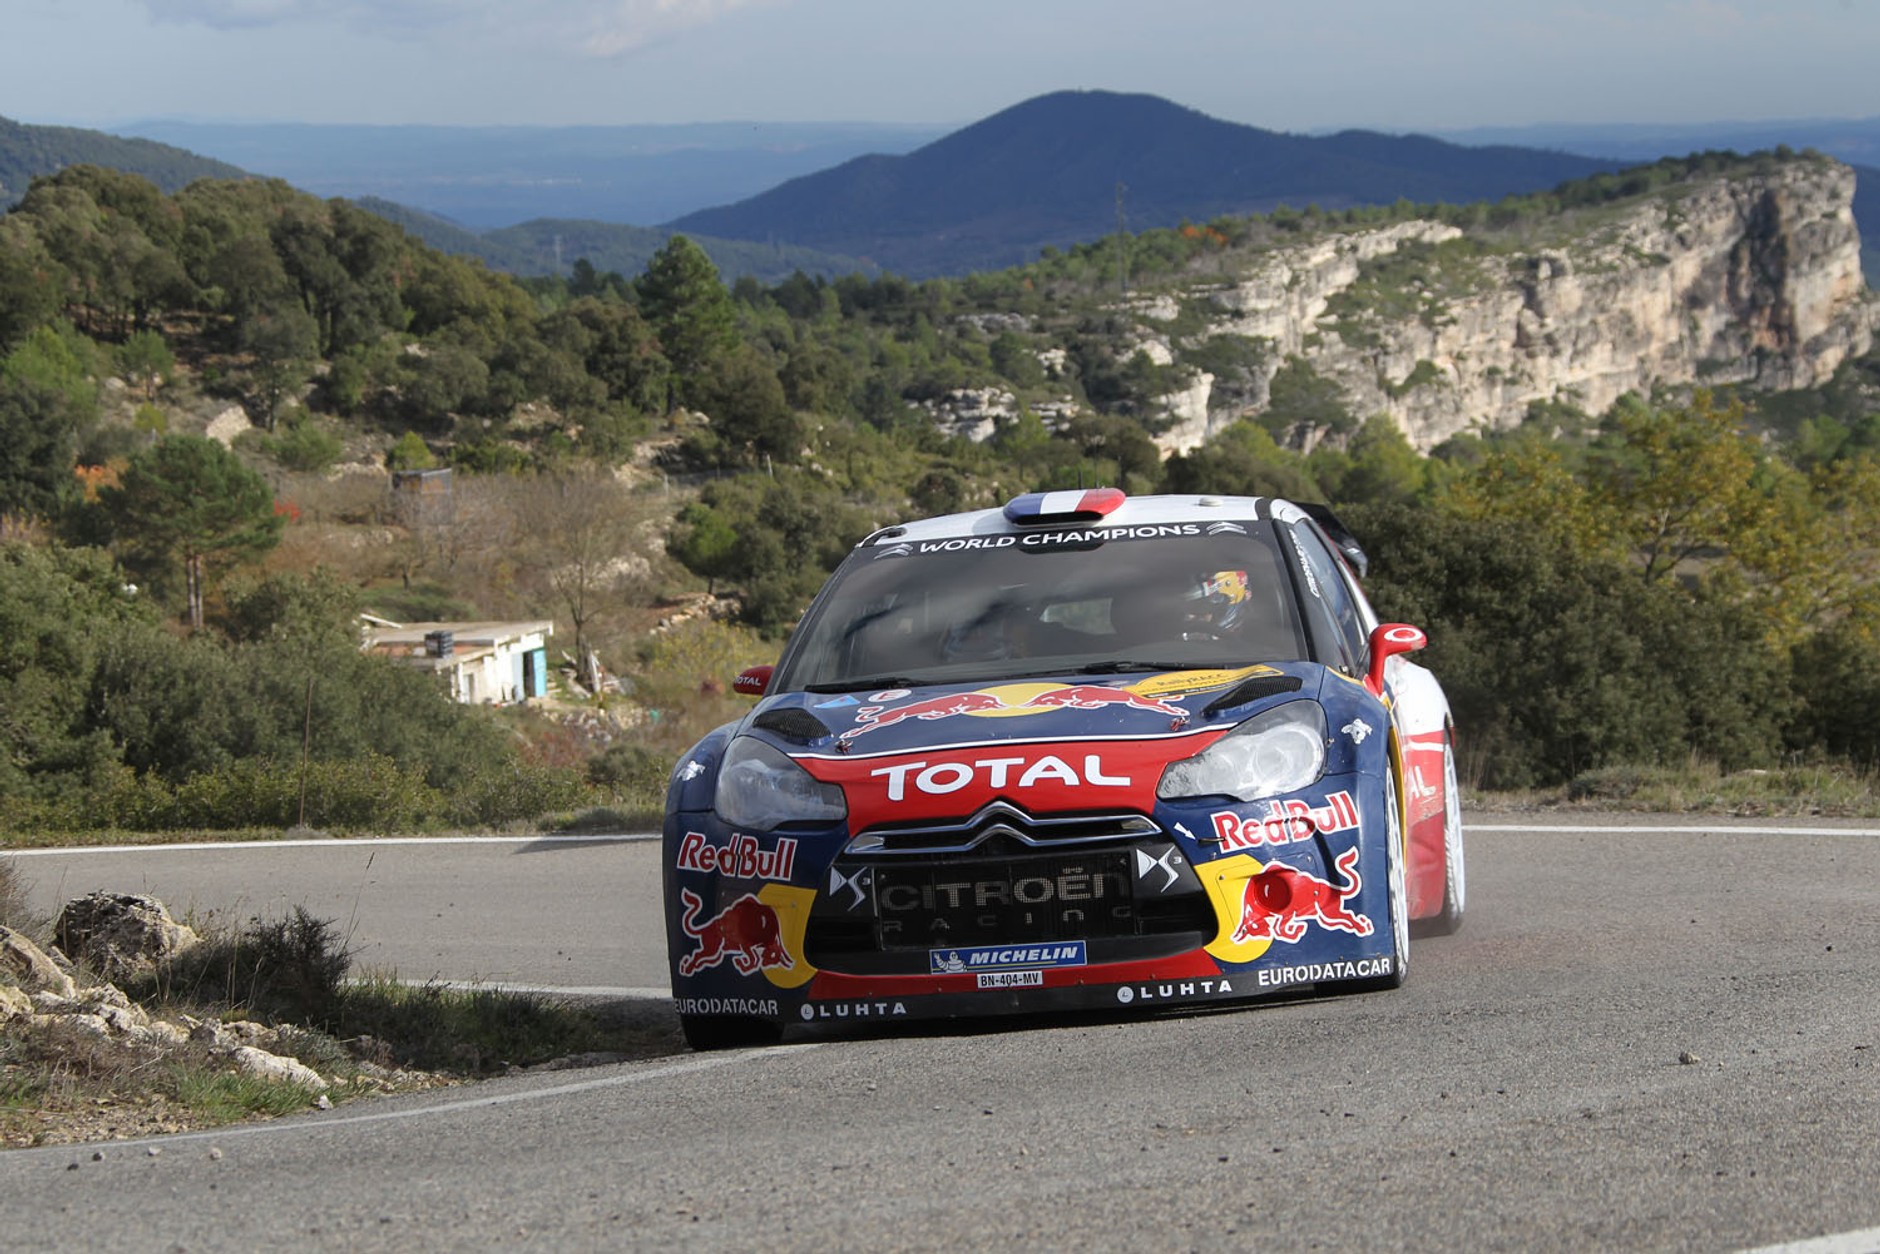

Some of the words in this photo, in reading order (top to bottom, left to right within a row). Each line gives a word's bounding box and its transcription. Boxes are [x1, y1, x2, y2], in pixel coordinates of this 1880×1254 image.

[919, 537, 1014, 553] WORLD
[1022, 524, 1201, 546] CHAMPIONS
[870, 754, 1131, 802] TOTAL
[969, 946, 1078, 966] MICHELIN
[980, 972, 1040, 988] BN-404-MV
[1258, 958, 1391, 986] EURODATACAR
[1140, 979, 1233, 999] LUHTA
[819, 1002, 908, 1017] LUHTA
